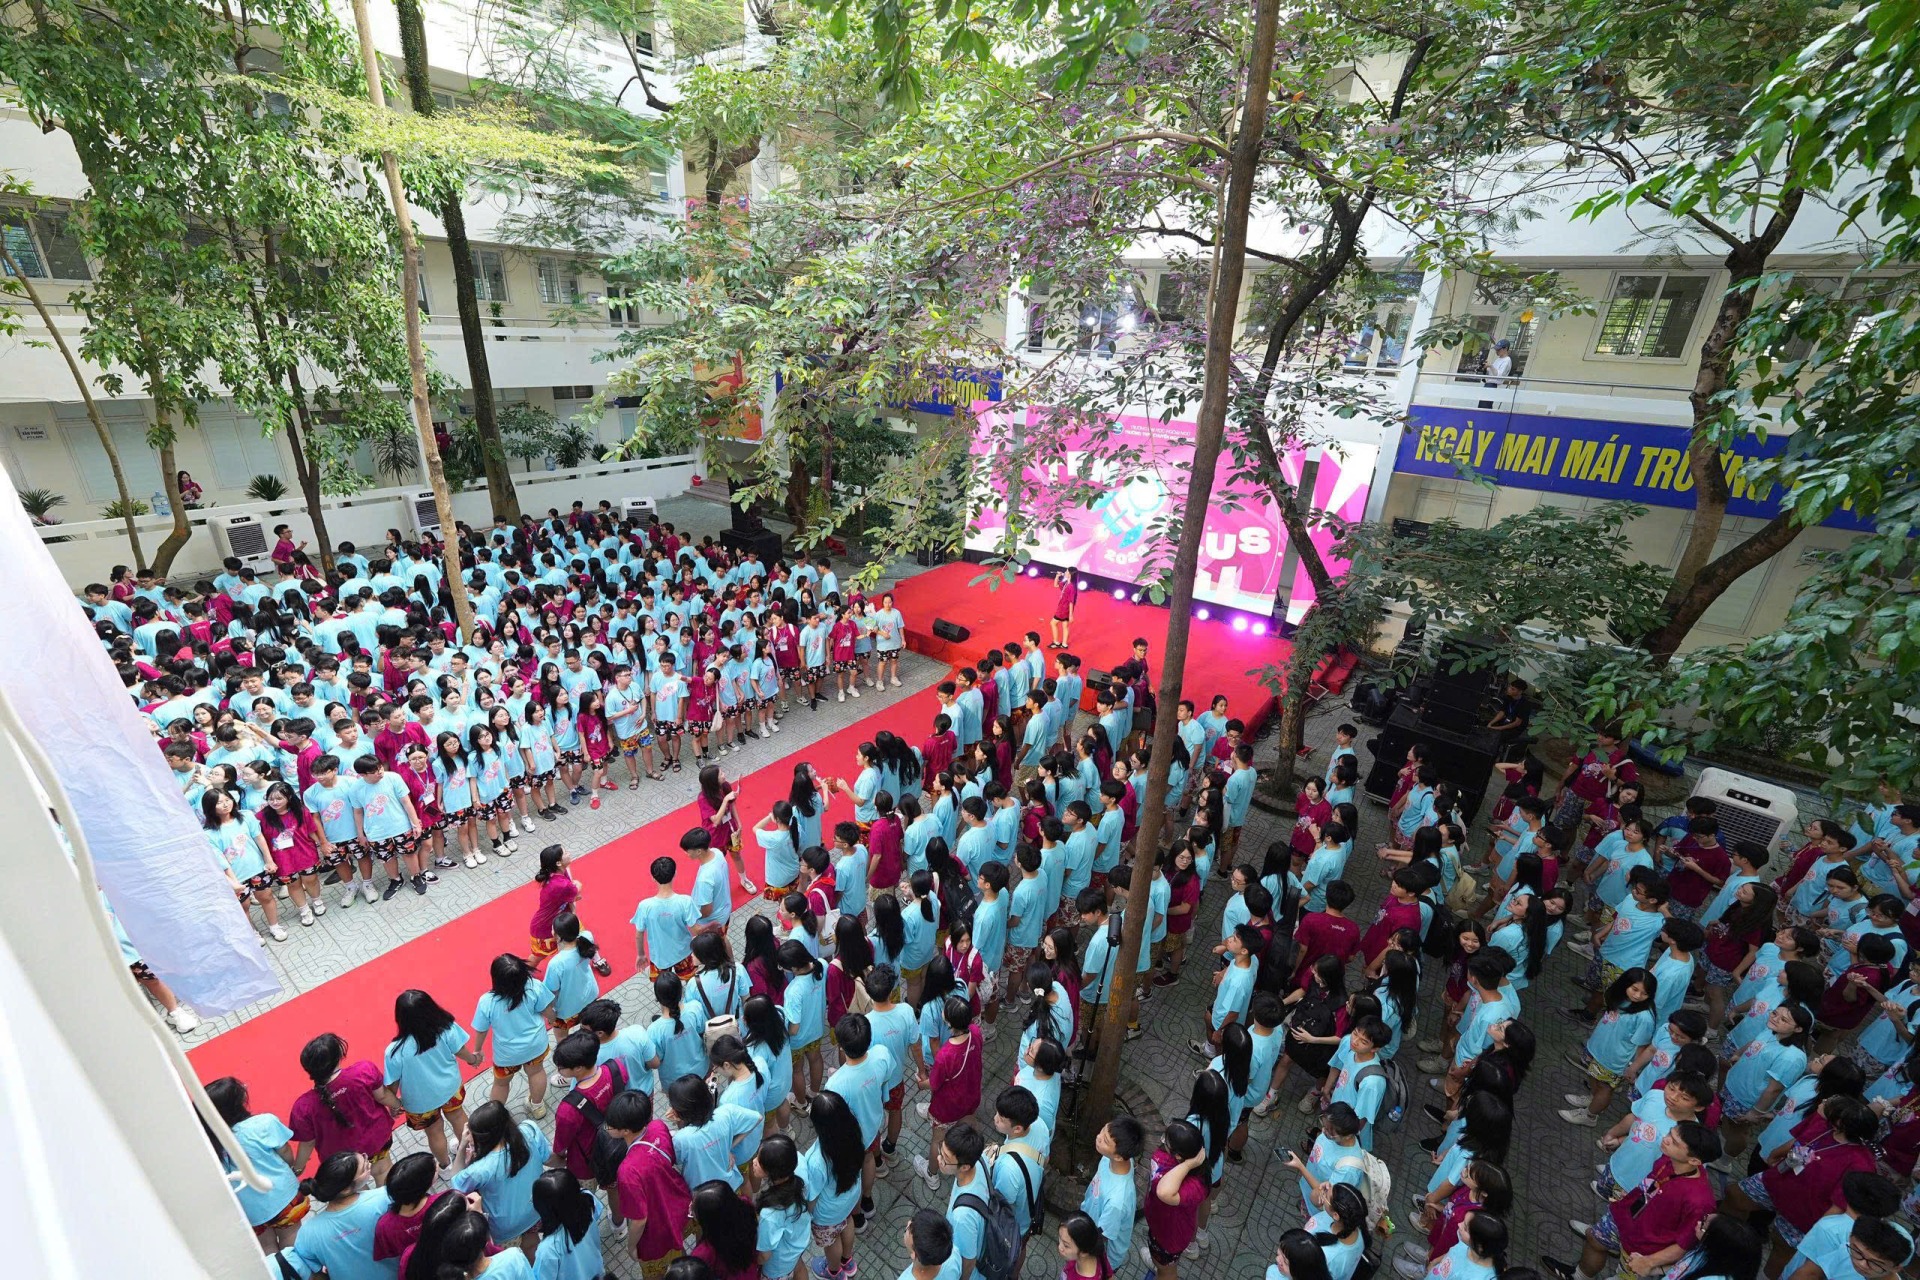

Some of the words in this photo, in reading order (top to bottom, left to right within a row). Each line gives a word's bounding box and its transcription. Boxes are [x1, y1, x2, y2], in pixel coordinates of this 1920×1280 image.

[1415, 420, 1496, 468] NGÀY
[1494, 432, 1560, 476] MAI
[1560, 434, 1632, 484] MÁI
